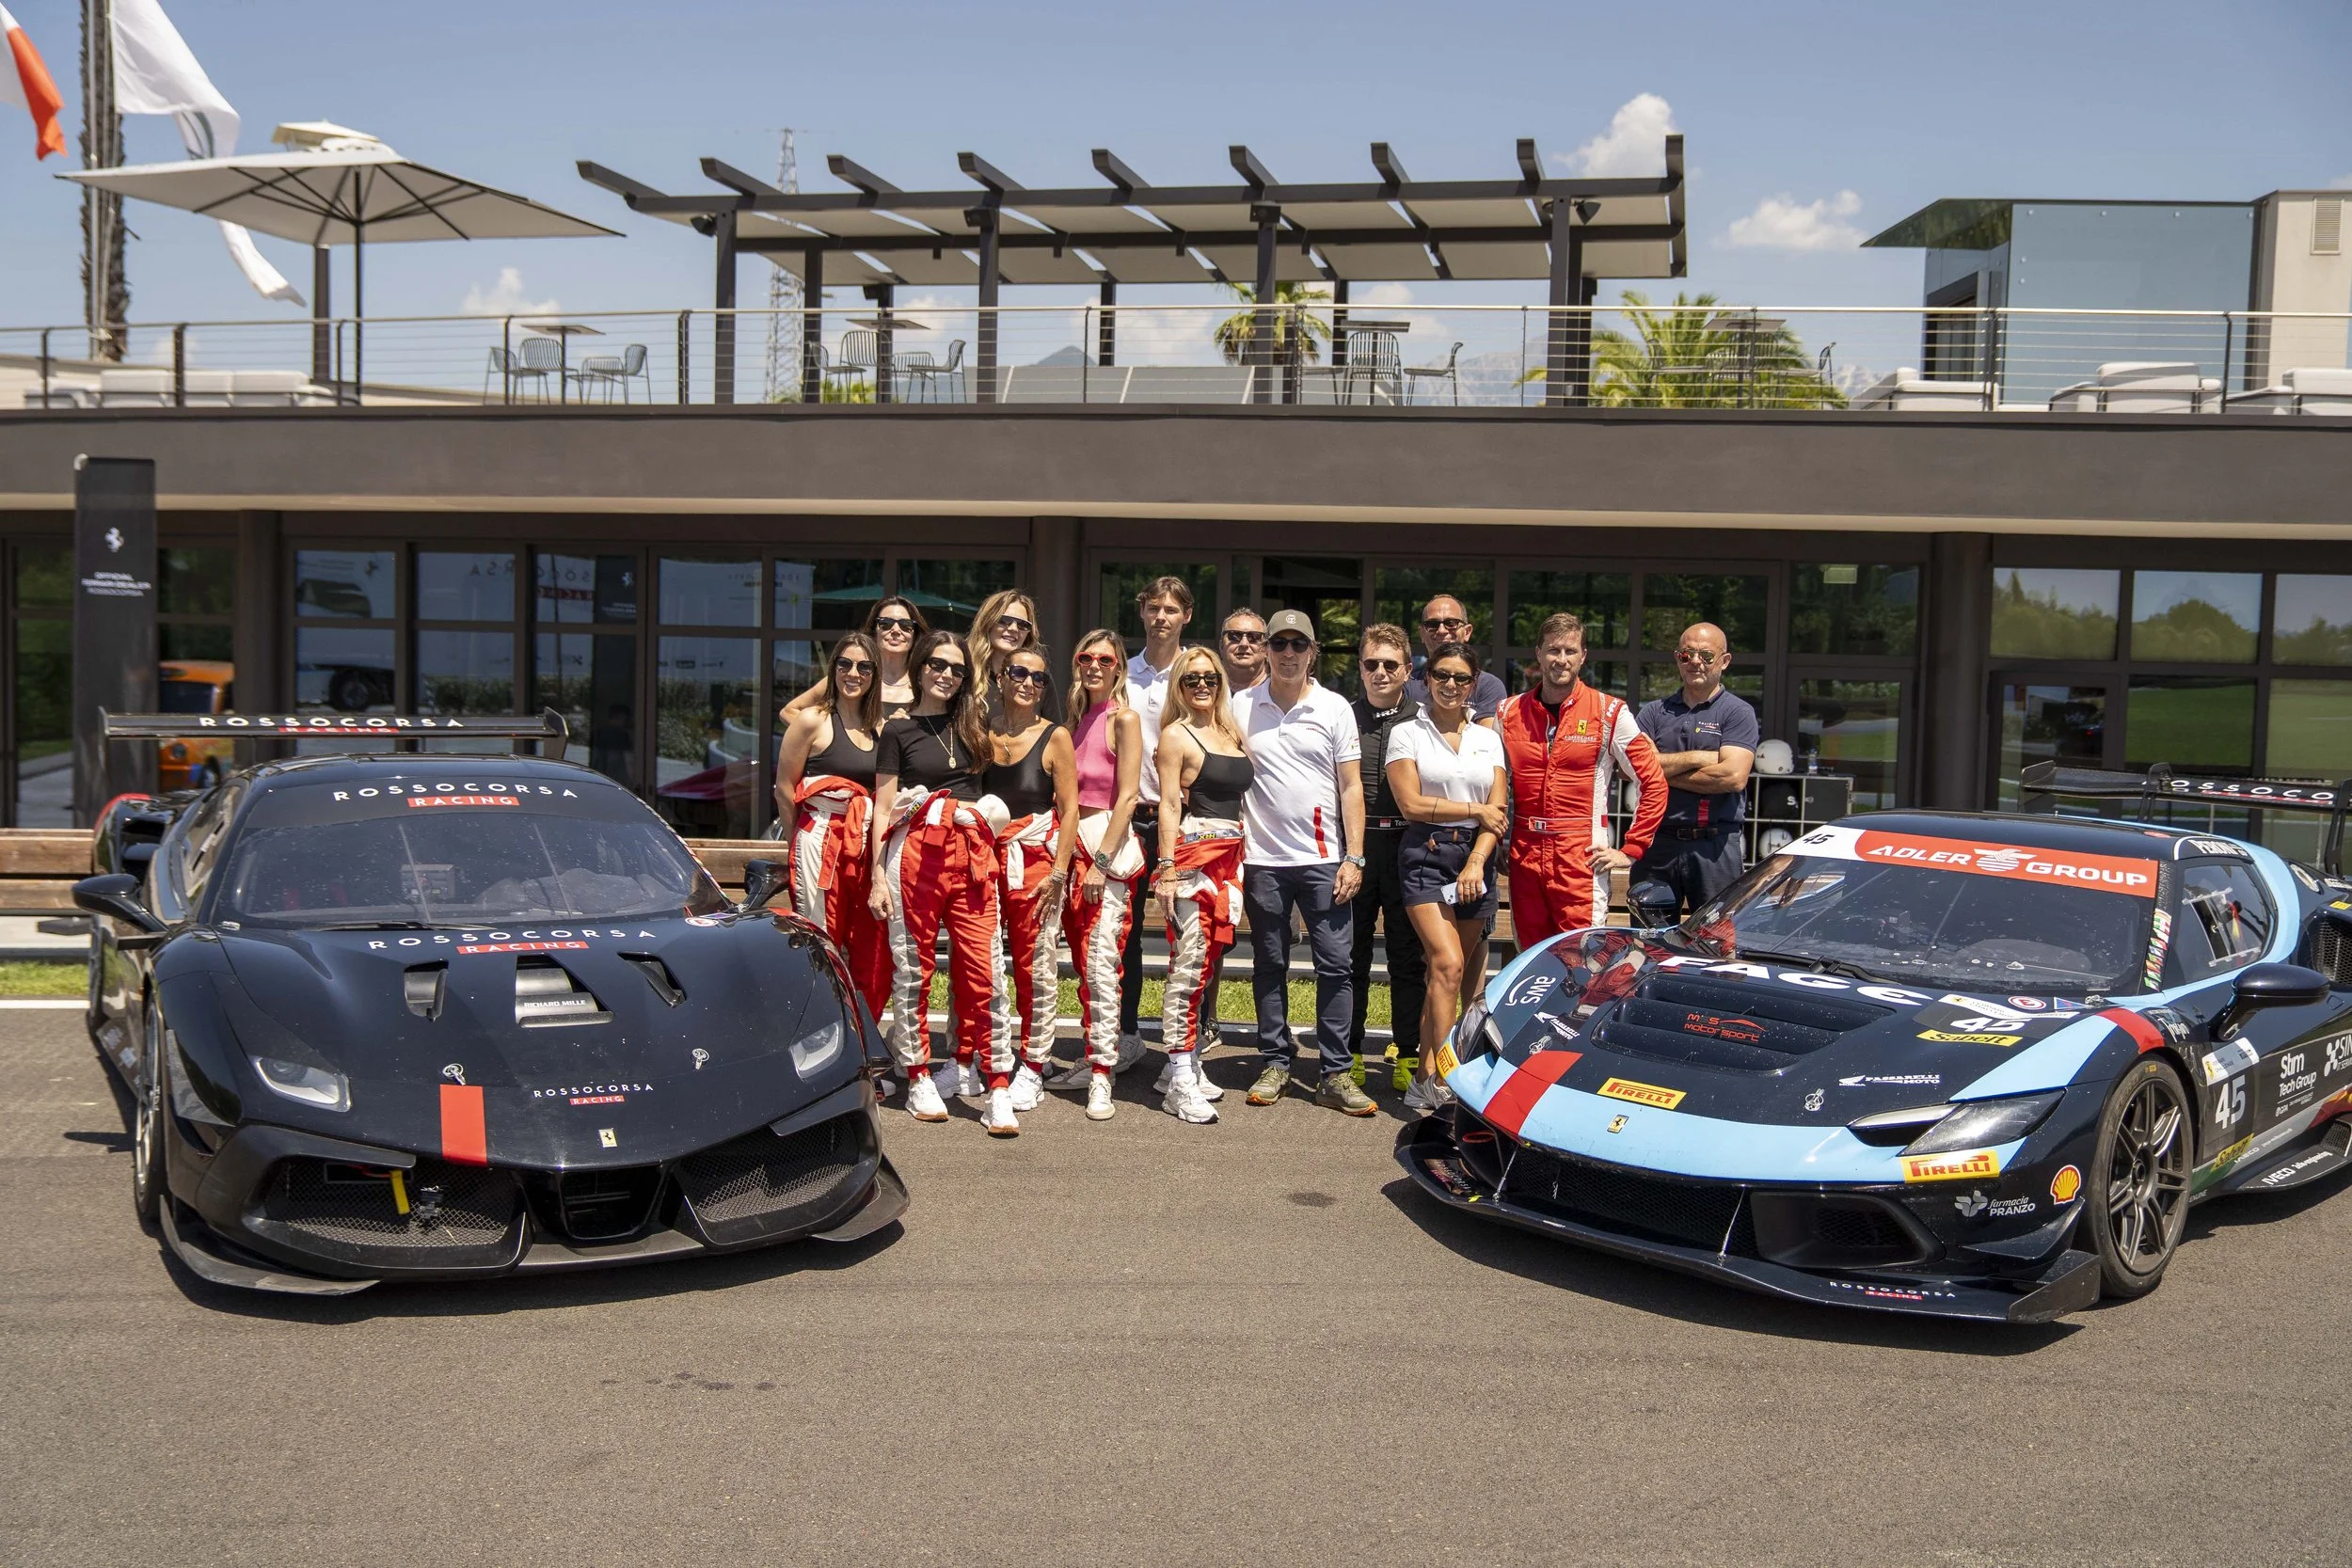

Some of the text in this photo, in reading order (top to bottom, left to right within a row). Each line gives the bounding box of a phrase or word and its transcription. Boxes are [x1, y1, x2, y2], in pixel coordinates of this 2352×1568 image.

[1375, 706, 1399, 719] HRX
[199, 717, 464, 728] ROSSOCORSA
[333, 783, 579, 801] ROSSOCORSA
[415, 796, 513, 807] RACING
[1803, 833, 1836, 845] 45
[1867, 846, 2148, 886] ADLER GROUP
[368, 929, 657, 950] ROSSOCORSA
[467, 942, 581, 954] RACING
[1950, 1017, 2033, 1033] 45
[1929, 1031, 2010, 1044] Sabelt
[1437, 1045, 1454, 1074] PIRELLI
[2296, 1071, 2317, 1090] Group
[533, 1084, 655, 1098] ROSSOCORSA
[1607, 1082, 1677, 1104] PIRELLI
[573, 1096, 623, 1105] RACING
[2215, 1074, 2246, 1130] 45
[1910, 1155, 1991, 1178] PIRELLI
[2261, 1167, 2296, 1185] IVECO
[1988, 1196, 2029, 1210] farmacia
[1989, 1202, 2036, 1217] PRANZO
[1830, 1281, 1955, 1298] ROSSOCORSA
[1868, 1291, 1918, 1300] RACING
